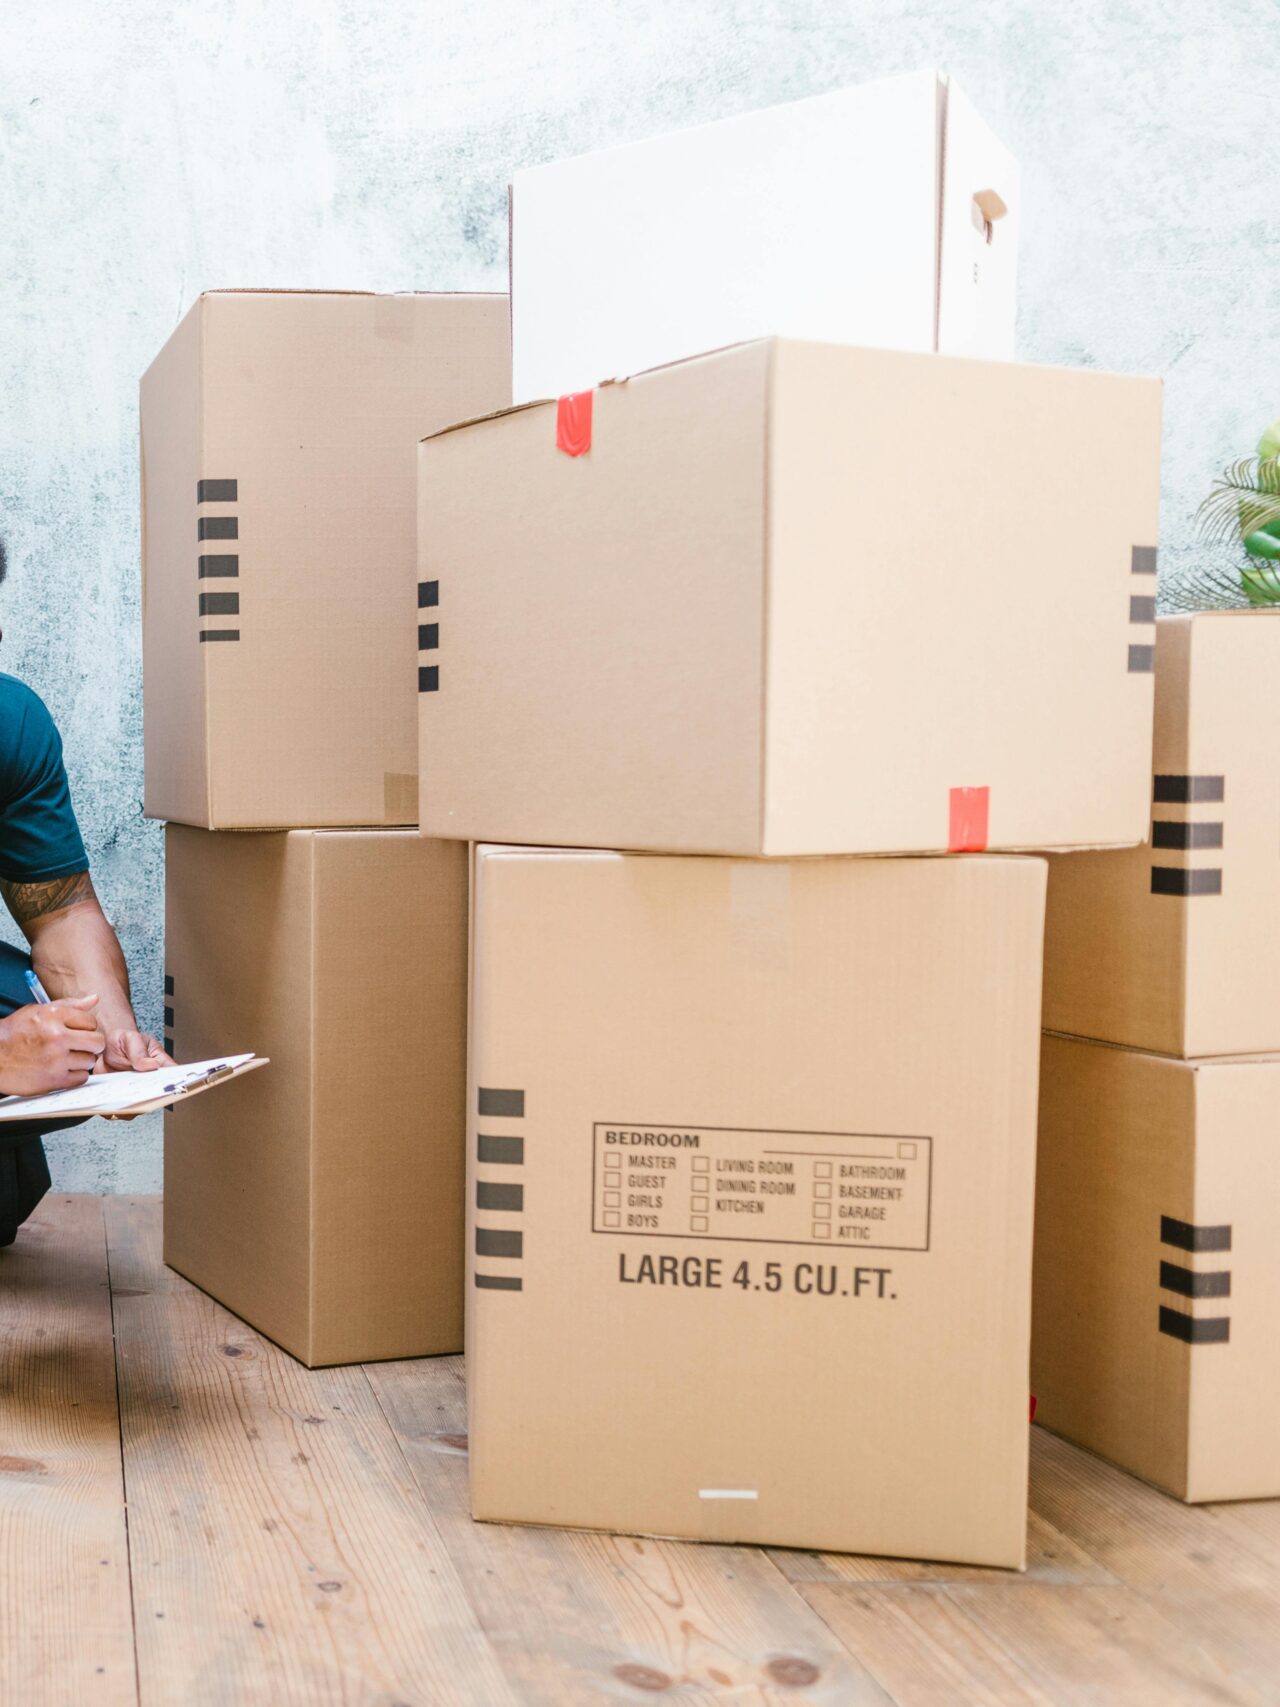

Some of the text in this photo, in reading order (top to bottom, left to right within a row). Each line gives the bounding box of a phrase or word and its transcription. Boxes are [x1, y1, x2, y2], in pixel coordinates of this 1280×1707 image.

[605, 1131, 700, 1148] BEDROOM
[628, 1154, 677, 1170] MASTER
[716, 1159, 794, 1175] LIVING ROOM
[839, 1164, 906, 1180] BATHROOM
[628, 1174, 667, 1189] GUEST
[716, 1179, 796, 1195] DINING ROOM
[839, 1184, 903, 1201] BASEMENT
[627, 1194, 663, 1208] GIRLS
[716, 1199, 765, 1214] KITCHEN
[627, 1214, 659, 1228] BOYS
[838, 1205, 887, 1221] GARAGE
[838, 1225, 871, 1240] ATTIC
[619, 1253, 723, 1289] LARGE
[732, 1260, 782, 1292] 4.5
